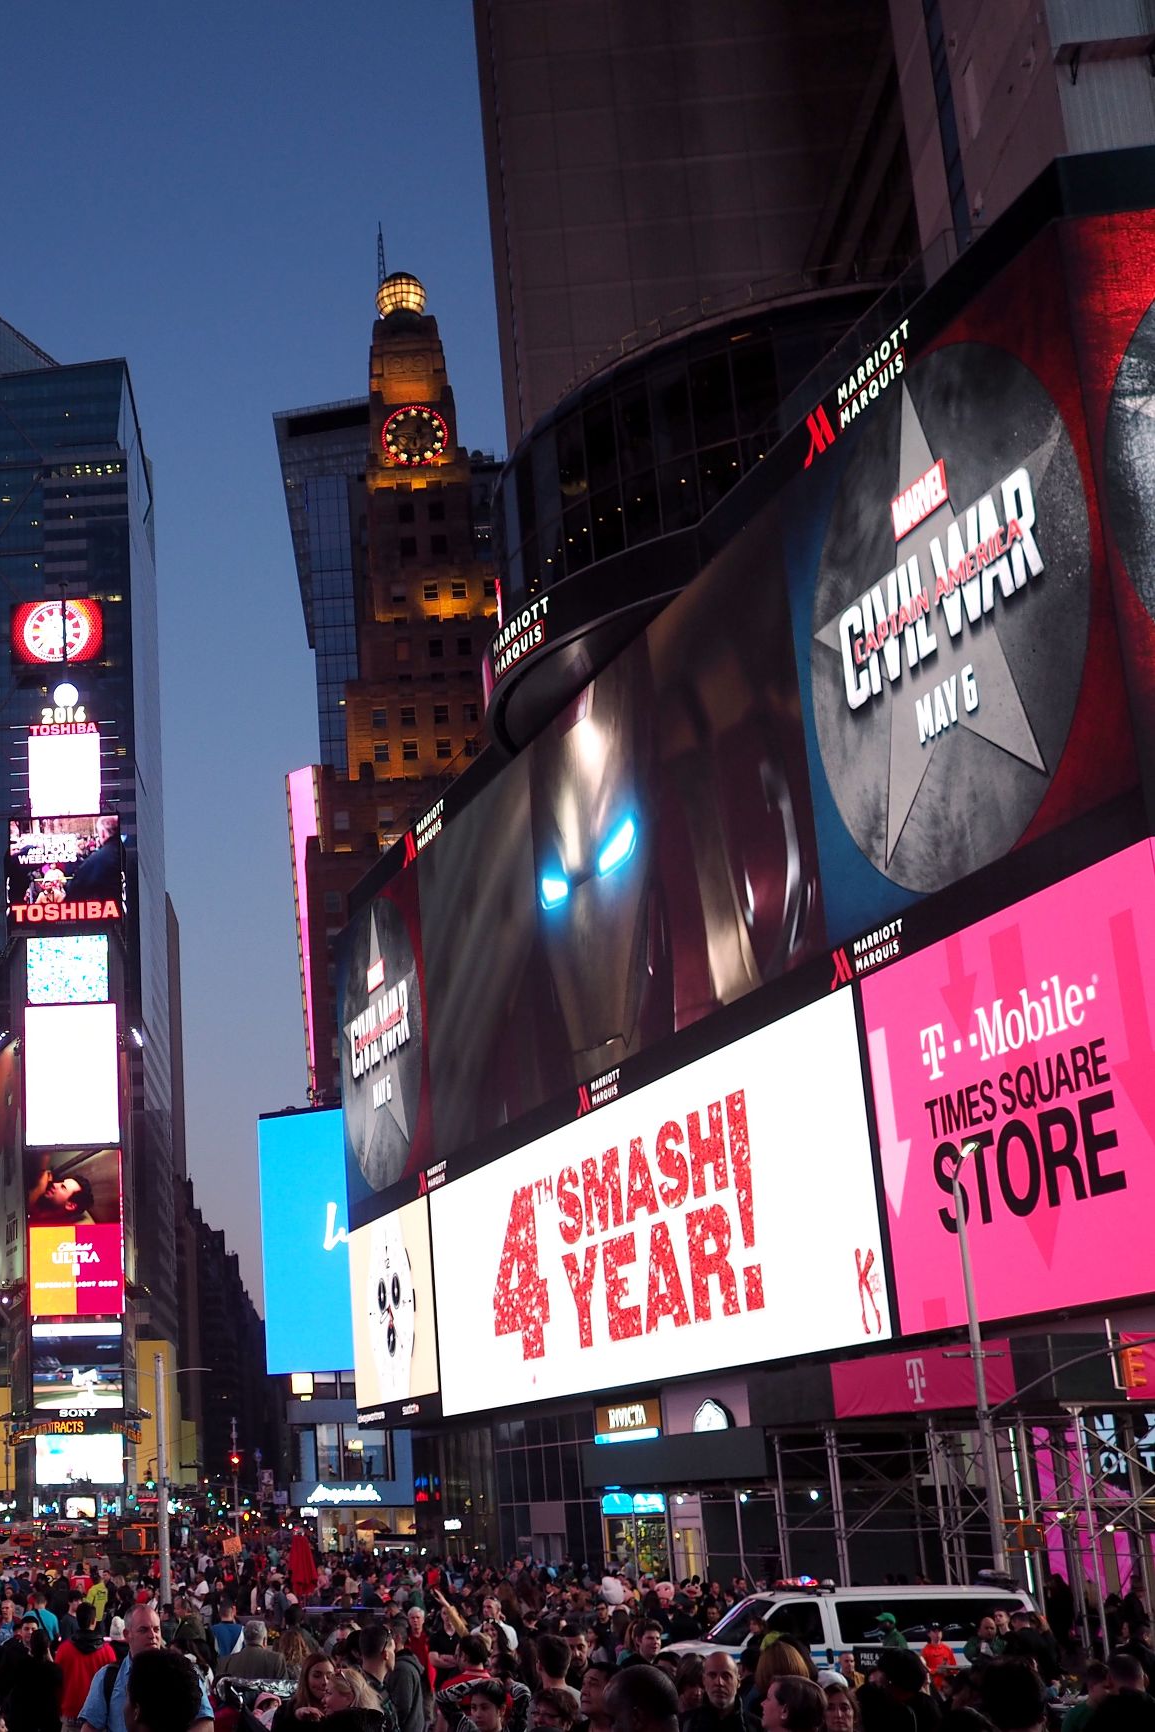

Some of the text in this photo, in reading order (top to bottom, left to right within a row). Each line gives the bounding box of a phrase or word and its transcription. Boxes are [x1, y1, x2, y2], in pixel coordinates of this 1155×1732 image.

[837, 319, 909, 405] MARRIOTT
[840, 354, 904, 429] MARQUIS
[891, 462, 948, 540] MARVEL
[929, 467, 1044, 639] WAR
[854, 519, 1024, 665] CAPTAIN AMERICA
[493, 596, 549, 656] MARRIOTT
[839, 555, 937, 710] CIVIL
[495, 625, 543, 678] MARQUIS
[41, 705, 87, 724] 2016
[915, 664, 979, 744] MAY 6
[29, 722, 98, 736] TOSHIBA
[416, 798, 444, 836] MARRIOTT
[417, 818, 443, 851] MARQUIS
[18, 852, 78, 865] WEEKENDS
[11, 900, 120, 923] TOSHIBA
[853, 918, 904, 956] MARRIOTT
[855, 940, 900, 973] MARQUIS
[590, 1068, 620, 1093] MARRIOTT
[591, 1084, 618, 1106] MARQUIS
[924, 1037, 1111, 1138] TIMES SQUARE
[932, 1090, 1127, 1235] STORE
[52, 1250, 100, 1264] ULTRA
[58, 1408, 98, 1418] SONY
[860, 1652, 874, 1660] FREE
